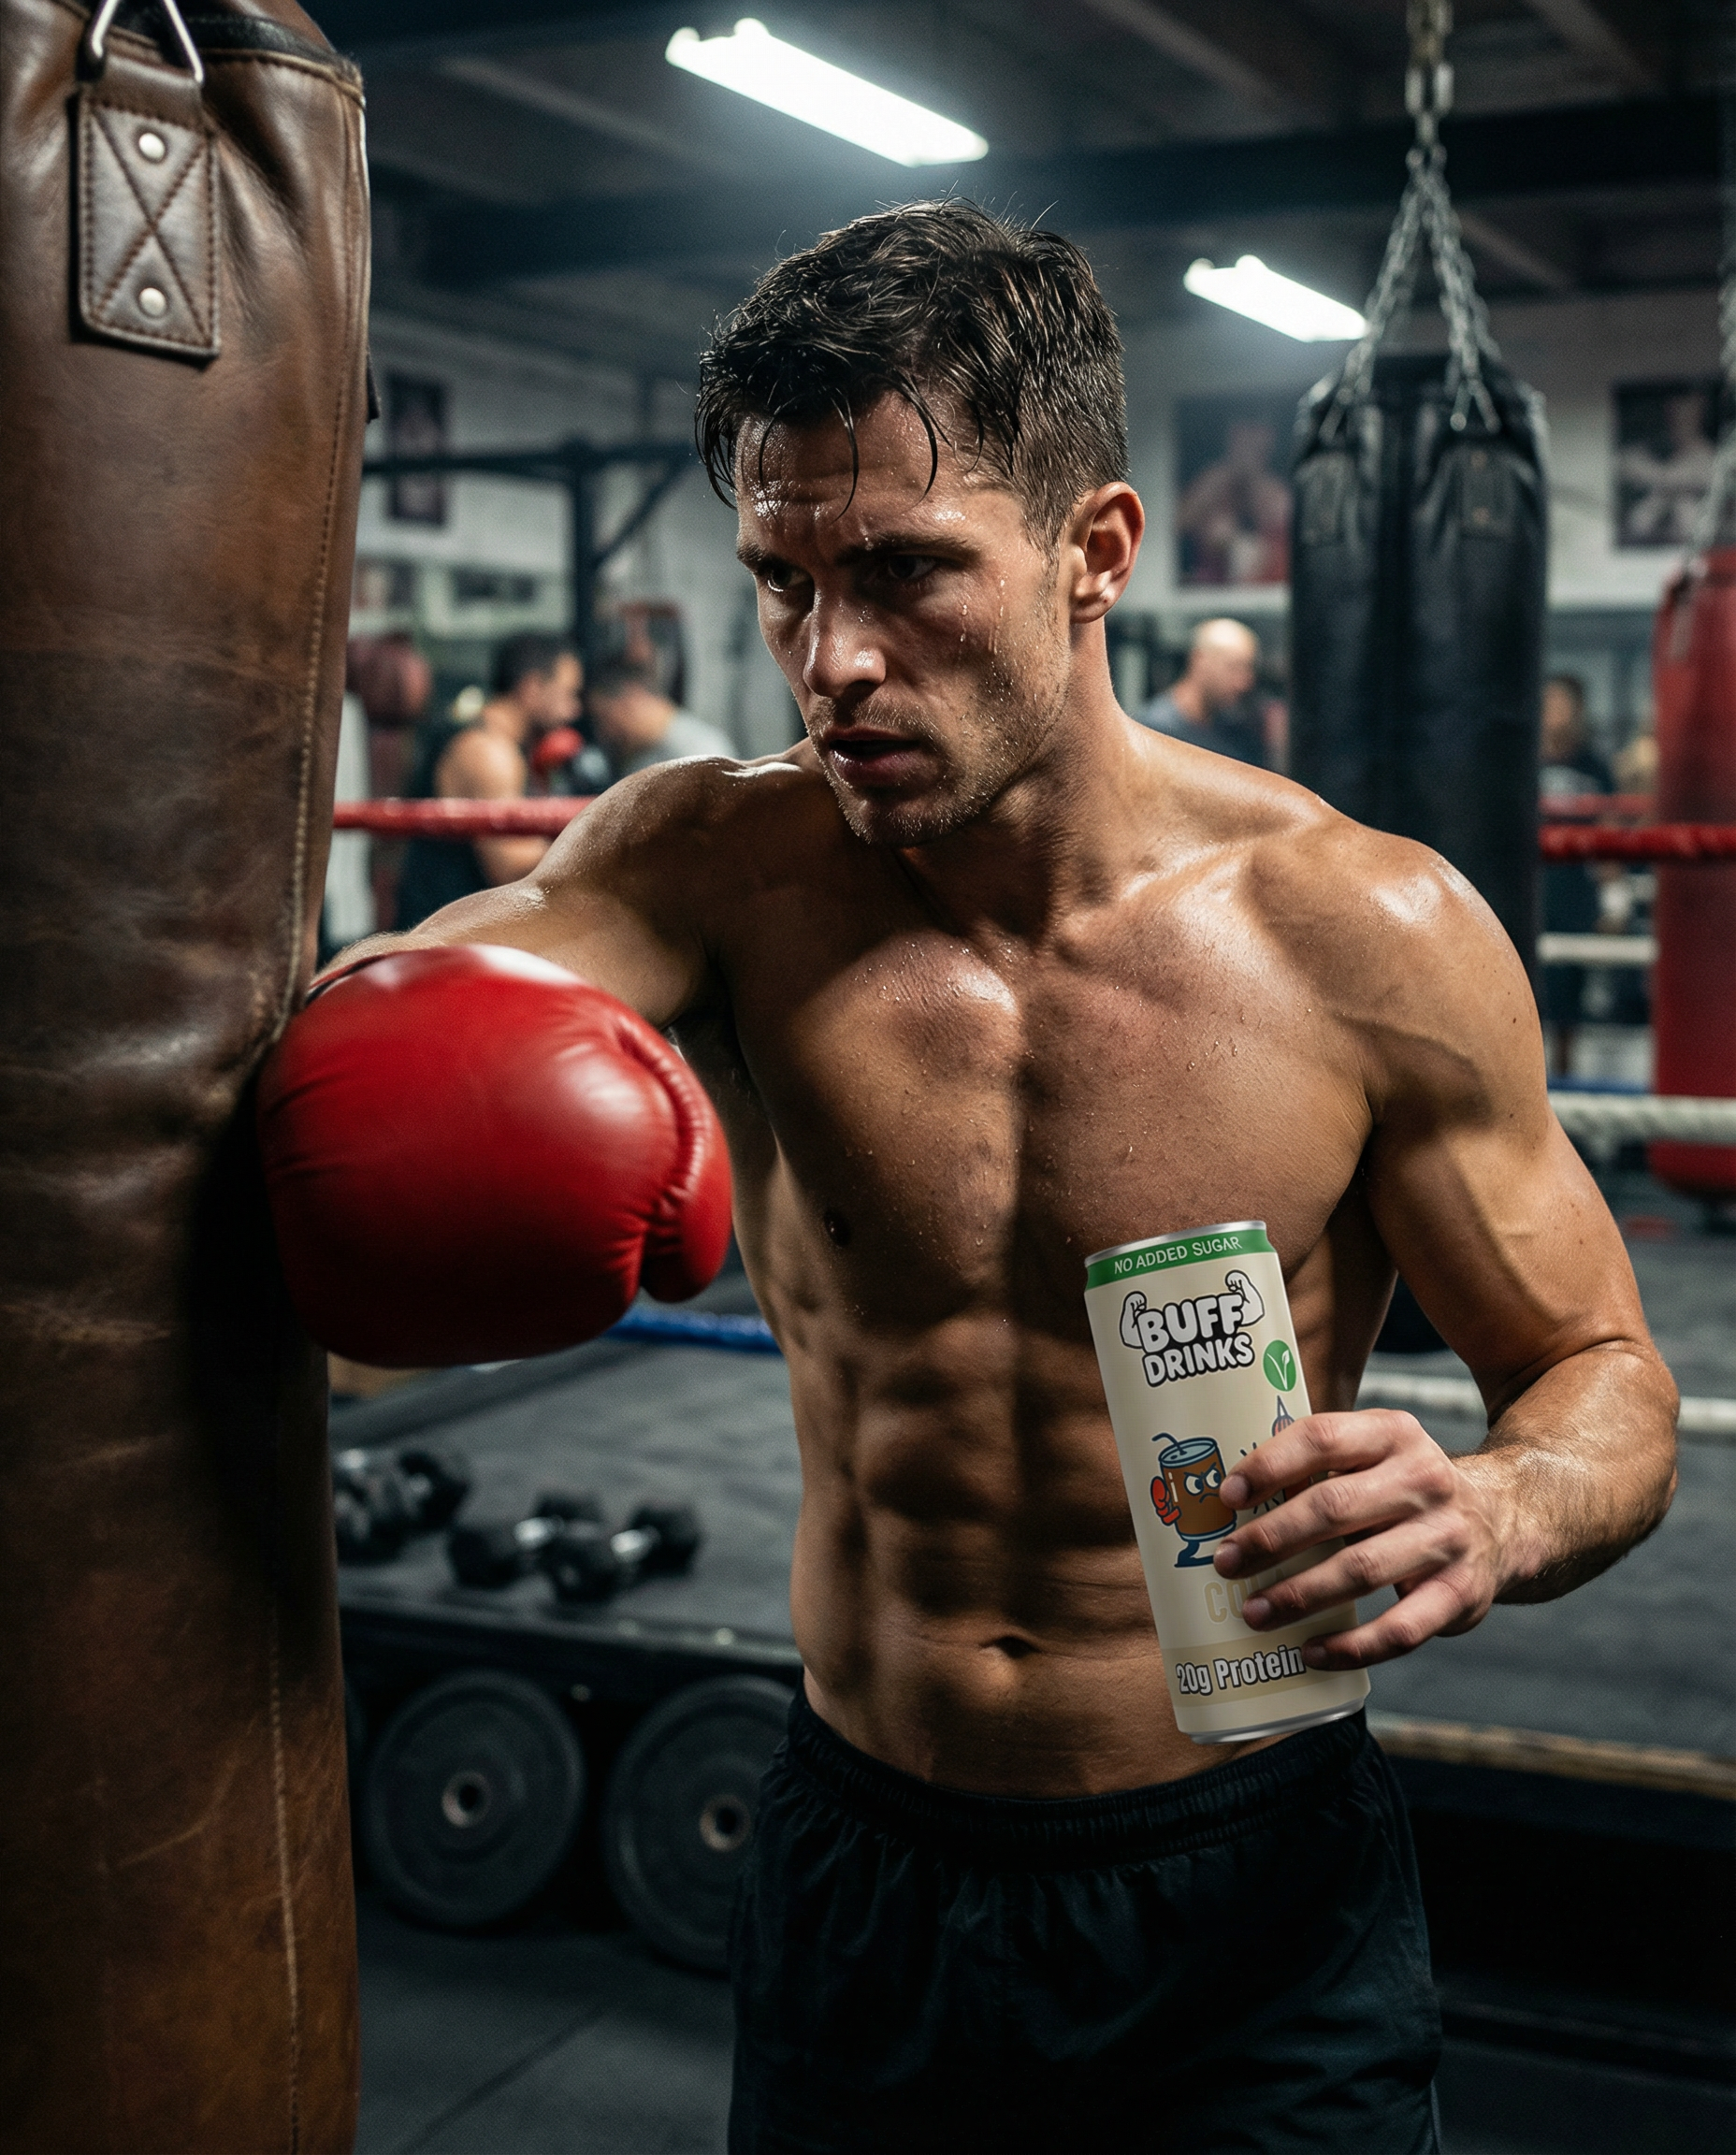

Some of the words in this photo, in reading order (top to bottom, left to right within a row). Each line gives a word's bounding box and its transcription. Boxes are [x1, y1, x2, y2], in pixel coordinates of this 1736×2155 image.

[1114, 1258, 1133, 1274] NO
[1136, 1246, 1188, 1269] ADDED
[1192, 1237, 1243, 1256] SUGAR
[1136, 1294, 1244, 1353] BUFF
[1143, 1332, 1253, 1386] DRINKS
[1204, 1568, 1285, 1624] CO
[1176, 1662, 1213, 1696] 20g
[1213, 1644, 1307, 1689] Protein
